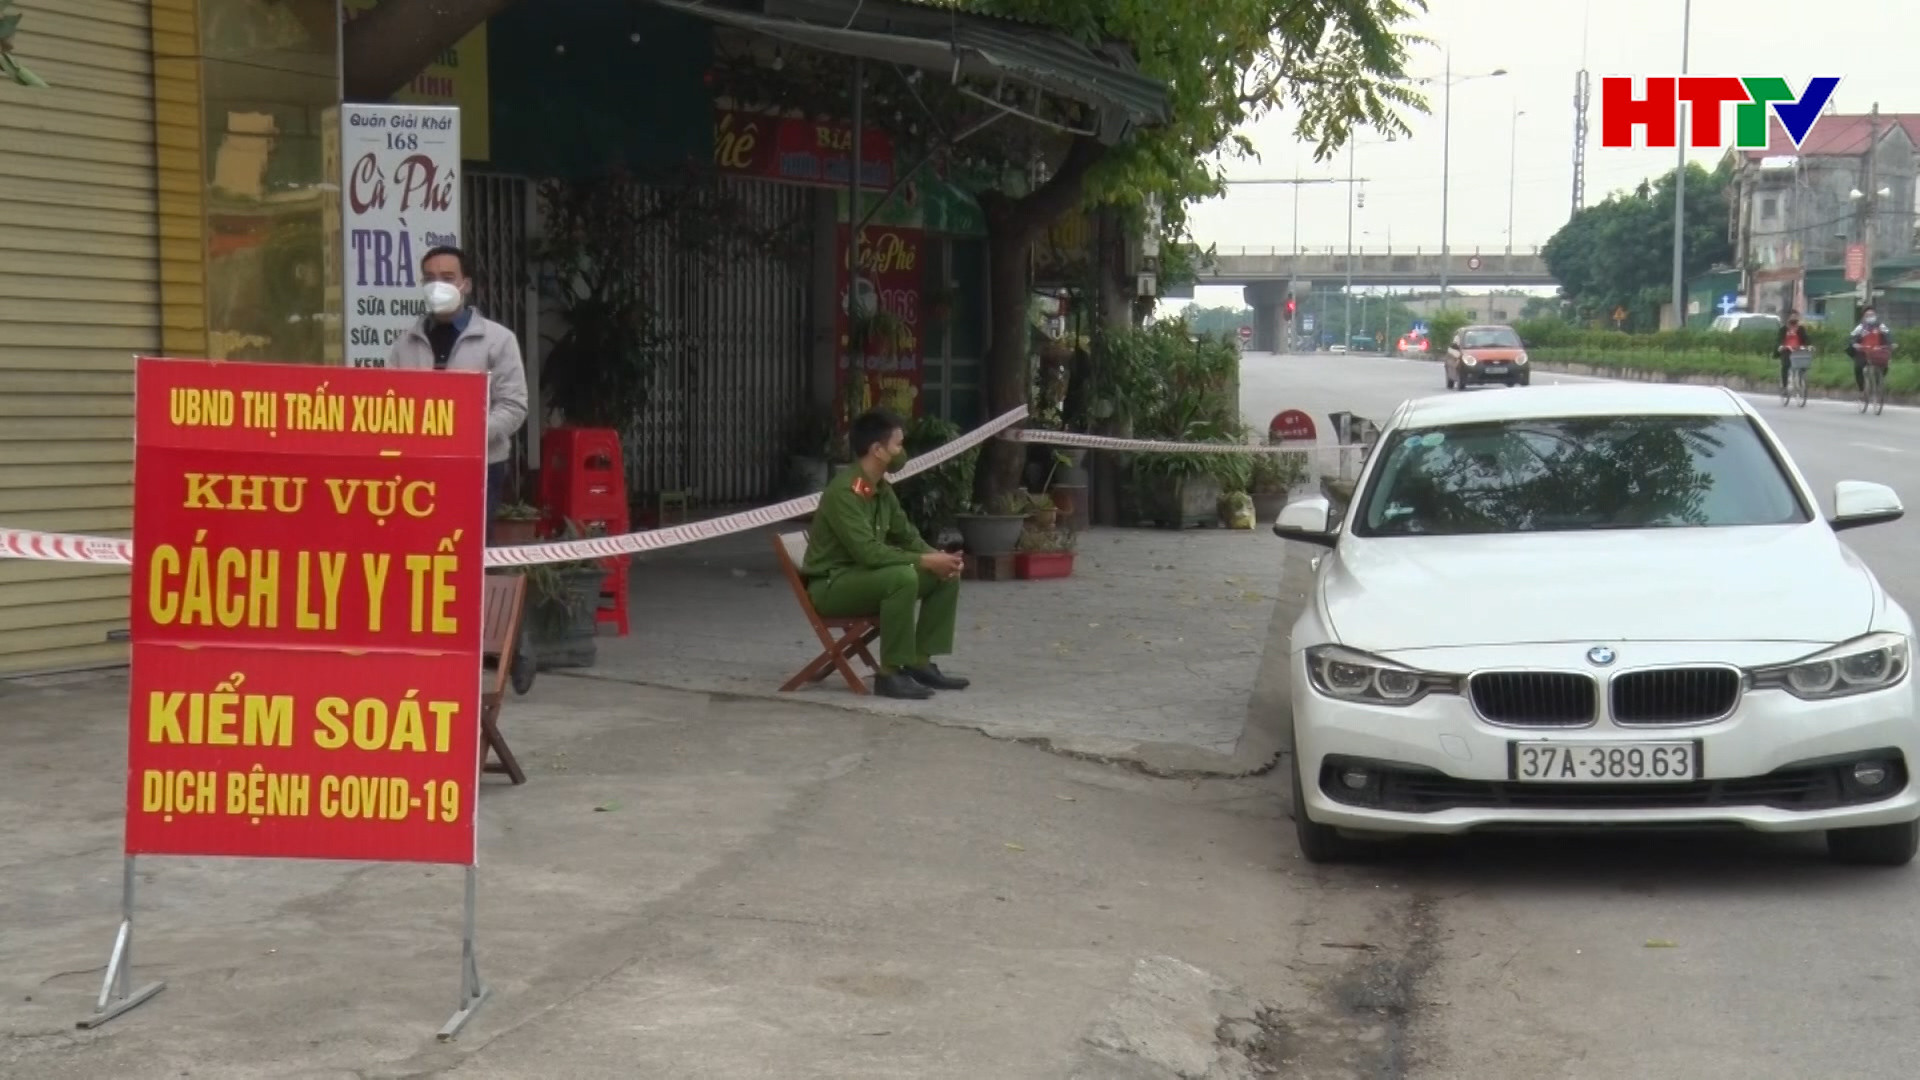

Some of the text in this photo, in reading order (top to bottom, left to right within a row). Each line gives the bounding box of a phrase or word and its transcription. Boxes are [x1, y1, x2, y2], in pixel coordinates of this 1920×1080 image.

[350, 113, 452, 130] Quán Giải Khát
[387, 132, 418, 151] 168
[350, 152, 455, 215] Cà Phê
[352, 218, 416, 287] TRÀ
[357, 295, 386, 316] SỮA
[350, 325, 380, 346] SỮA
[170, 381, 454, 438] UBND THỊ TRẤN XUÂN AN
[183, 473, 437, 526] KHU VỰC
[148, 529, 464, 634] CÁCH LY Y TẾ
[148, 672, 460, 753] KIỂM SOÁT
[1522, 747, 1689, 778] 37A-389.63
[143, 763, 460, 825] DỊCH BỆNH COVID-19
